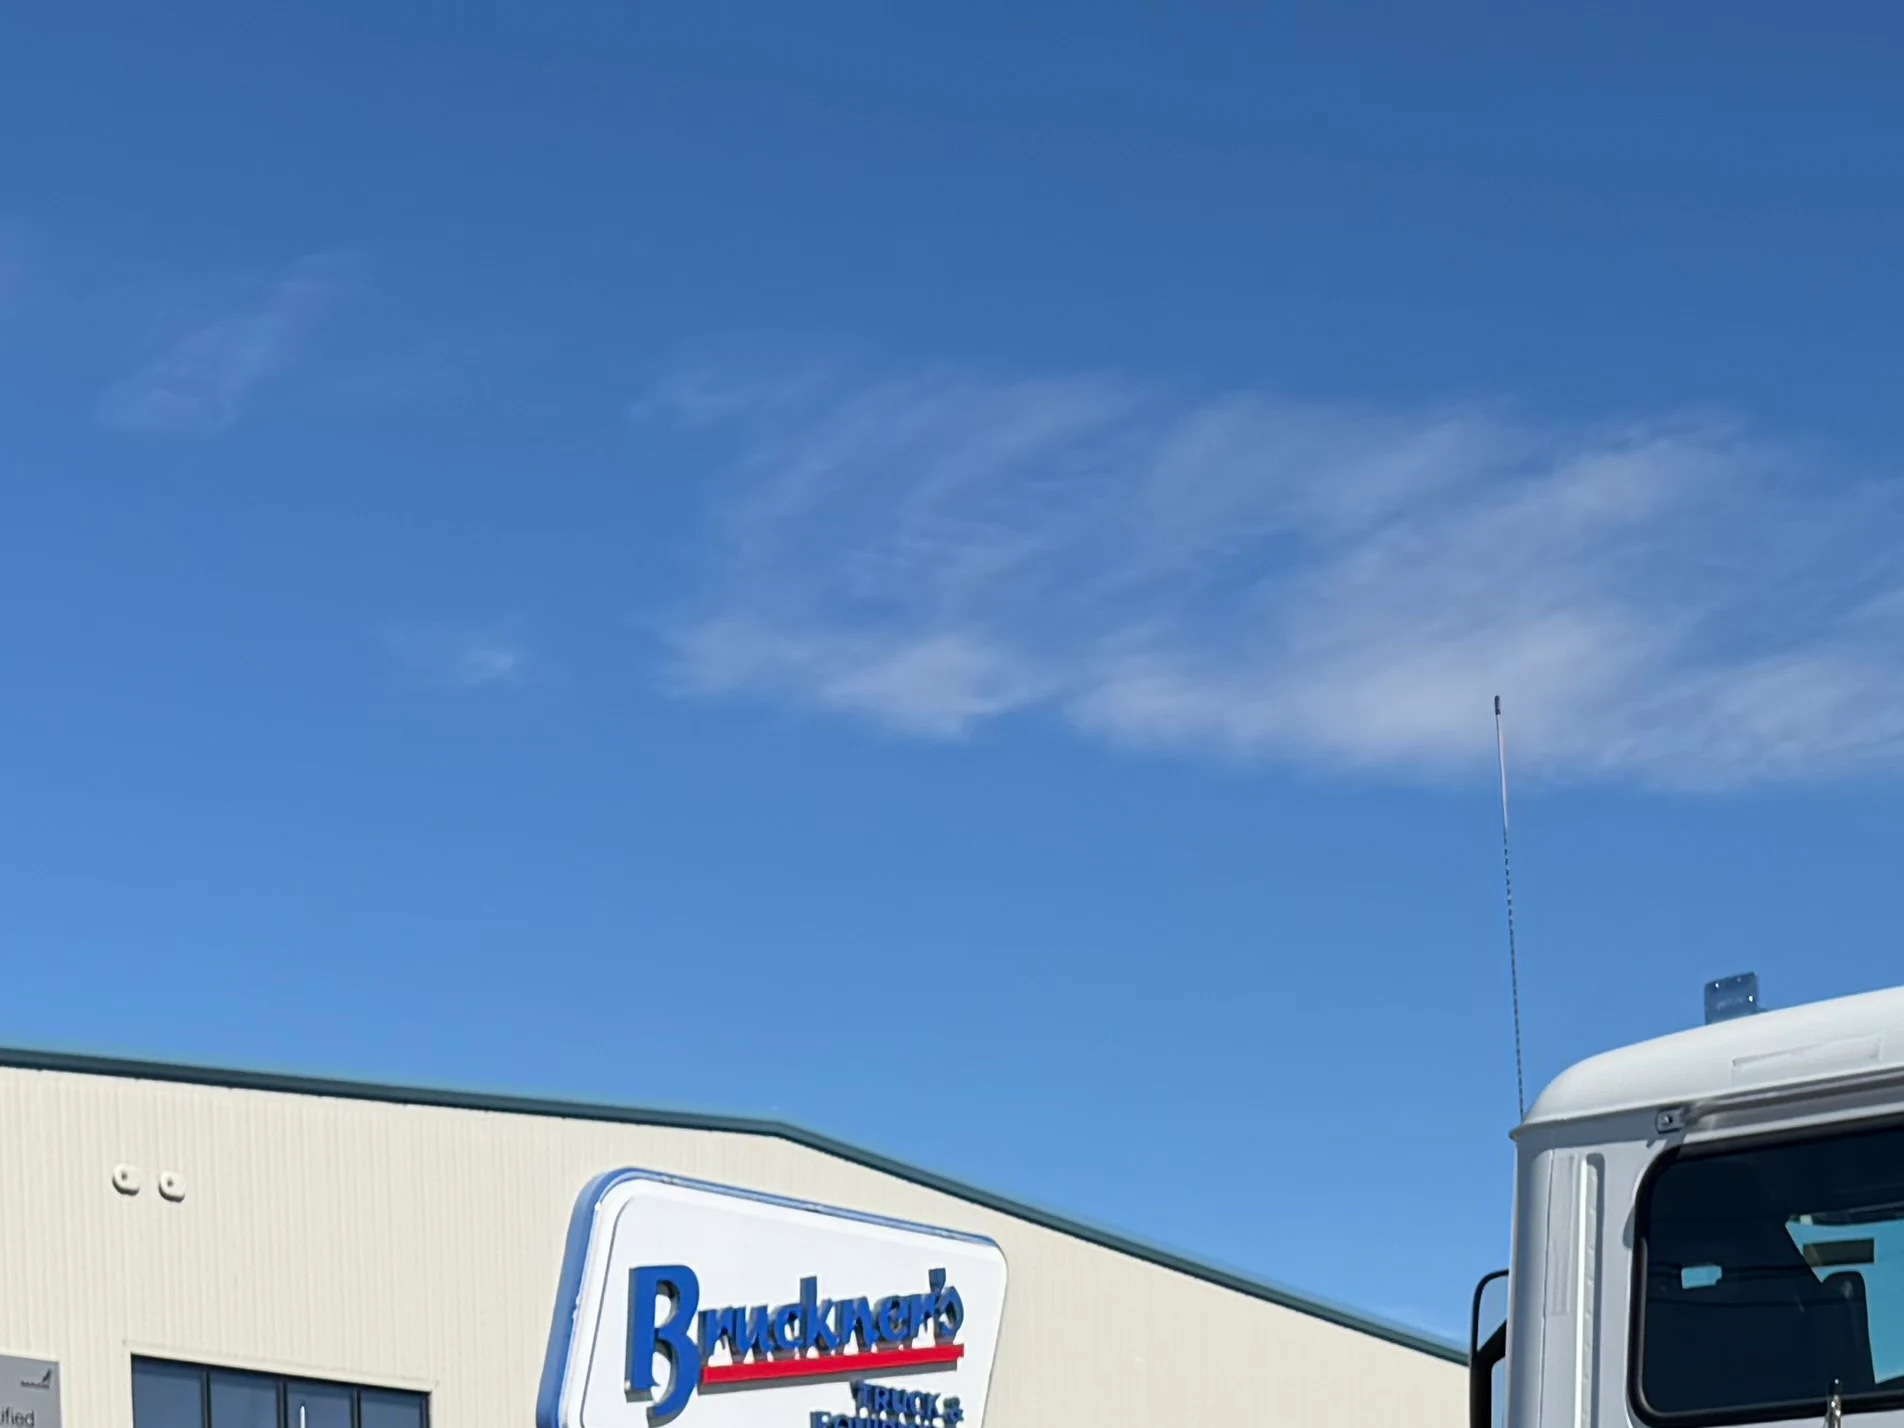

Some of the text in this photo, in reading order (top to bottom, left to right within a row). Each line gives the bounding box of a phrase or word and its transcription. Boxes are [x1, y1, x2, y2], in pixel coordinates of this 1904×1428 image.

[625, 1264, 964, 1428] Bruckner's
[853, 1379, 965, 1423] TRUCK &
